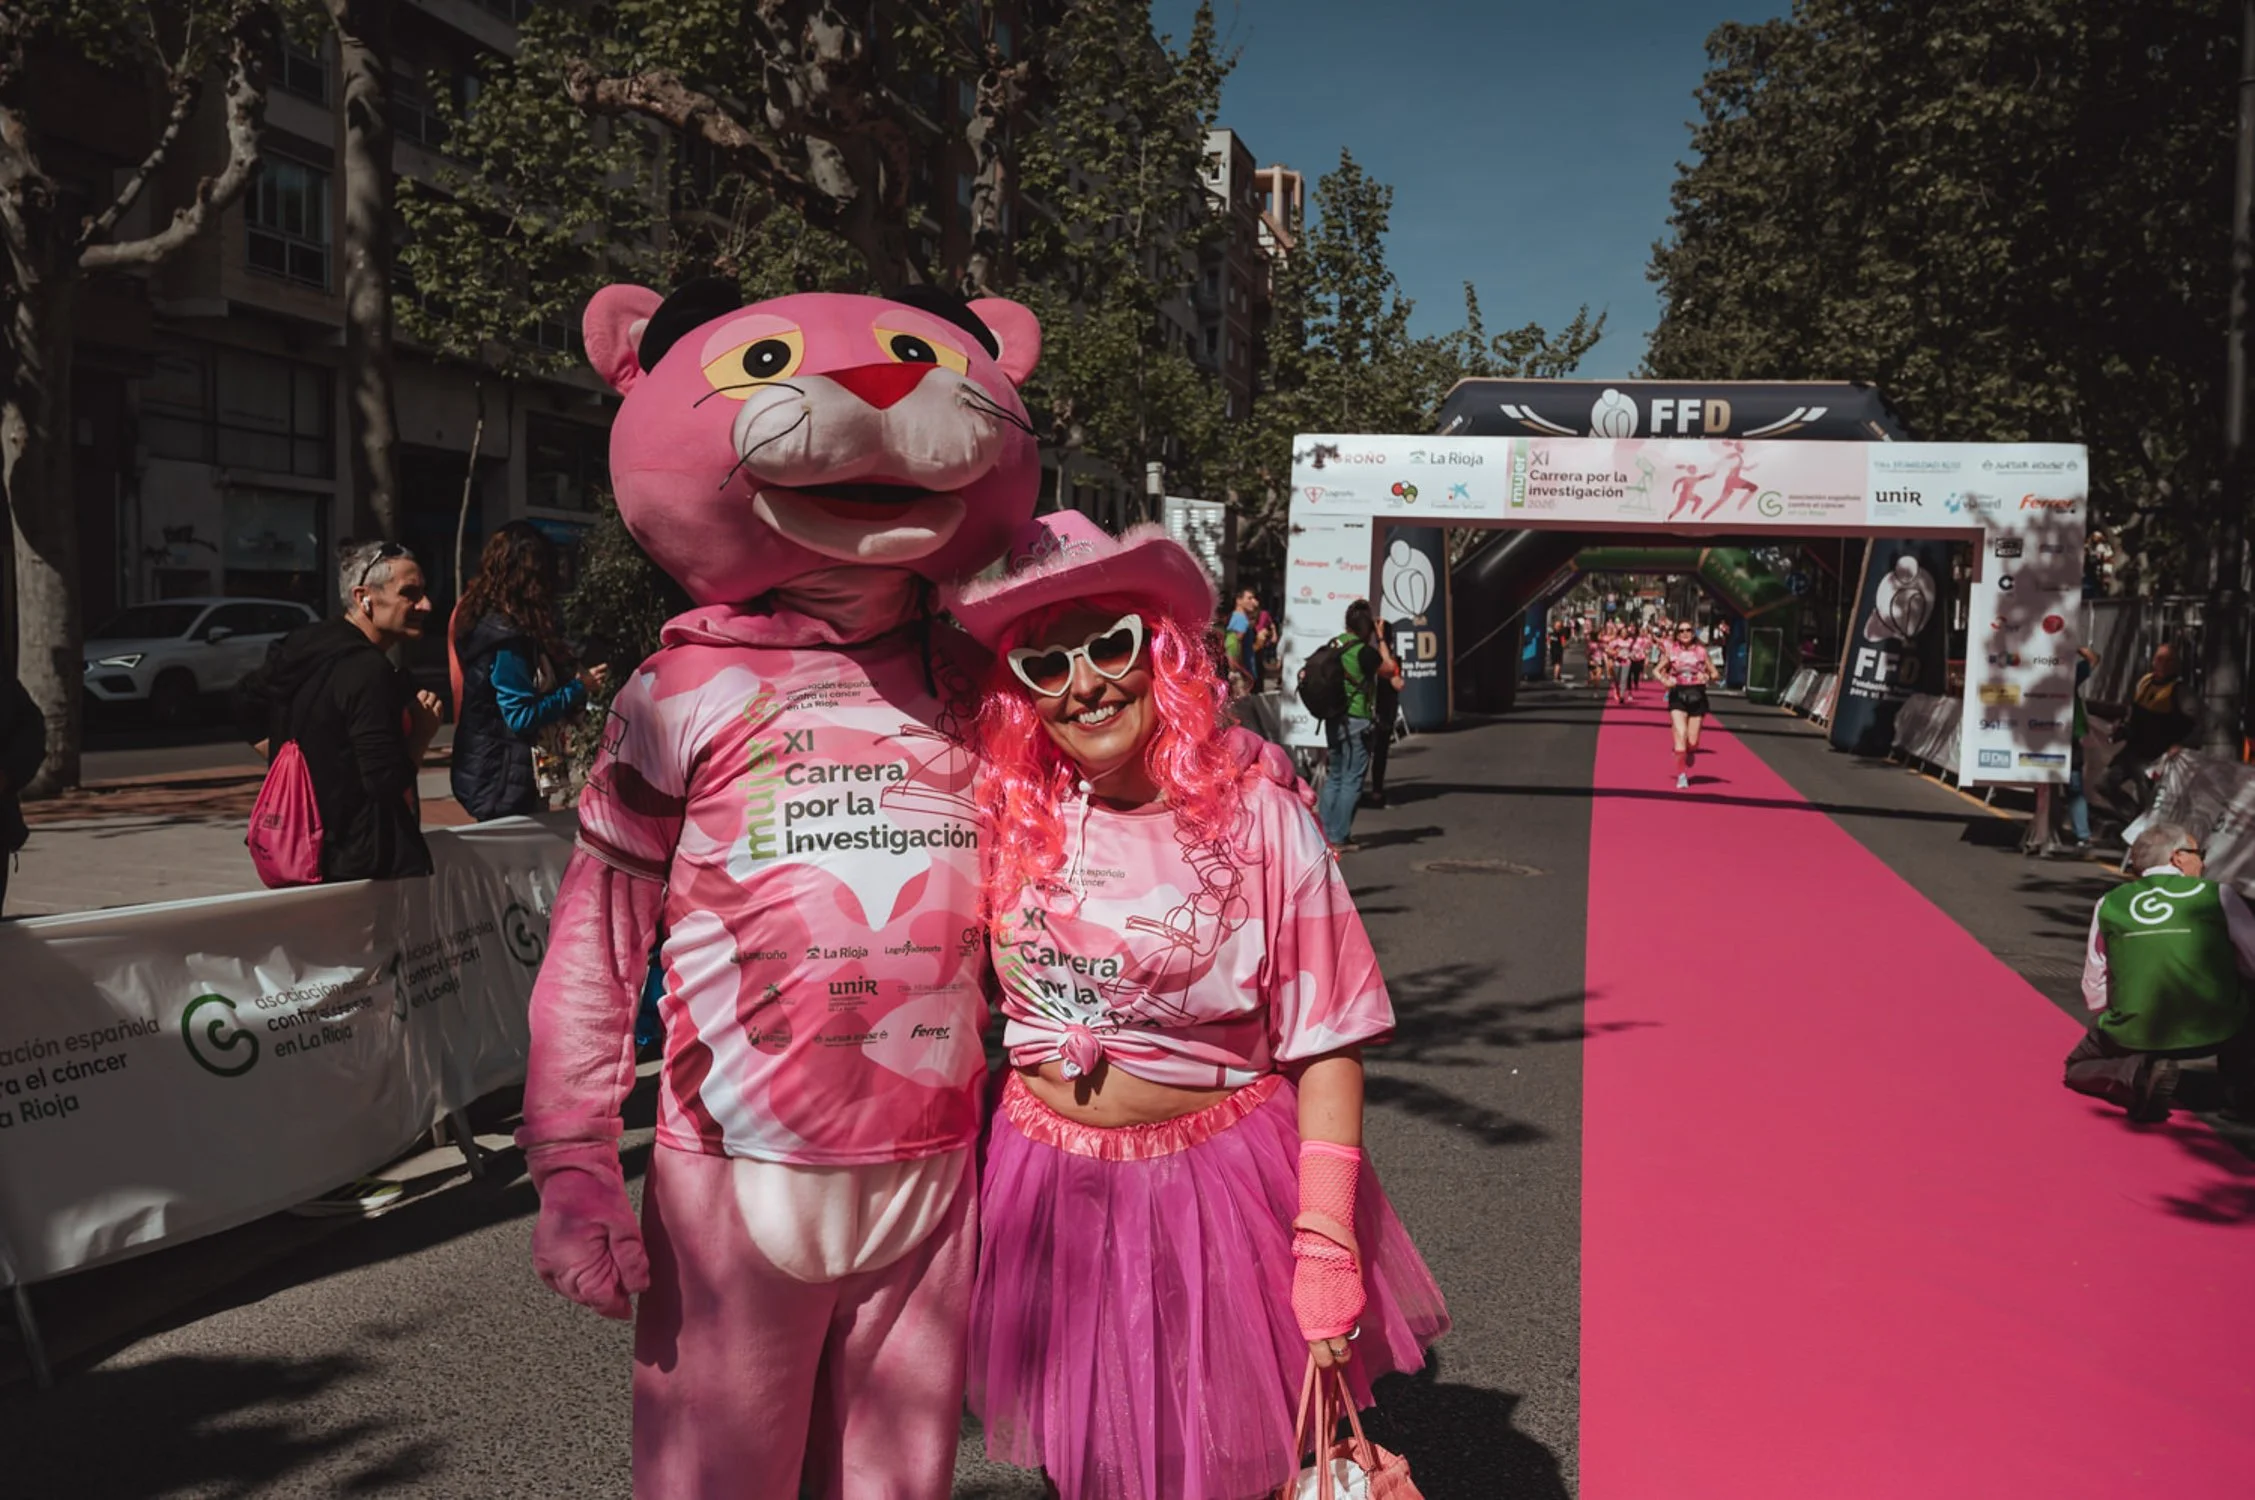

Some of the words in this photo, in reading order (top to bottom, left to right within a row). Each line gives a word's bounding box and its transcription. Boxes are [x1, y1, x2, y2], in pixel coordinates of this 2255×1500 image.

[1650, 399, 1732, 433] FFD
[1430, 452, 1445, 465] La
[1449, 451, 1484, 468] Rioja
[1531, 450, 1549, 466] XI
[1529, 470, 1582, 481] Carrera
[1587, 472, 1611, 485] por
[1614, 472, 1628, 483] la
[1528, 484, 1624, 500] investigación
[1396, 631, 1437, 660] FD
[783, 729, 815, 755] XI
[784, 760, 905, 786] Carrera
[737, 737, 785, 861] mujer
[785, 798, 842, 827] por
[846, 791, 876, 816] la
[786, 823, 979, 856] Investigación
[824, 948, 838, 959] La
[839, 946, 869, 960] Rioja
[255, 982, 341, 1010] asociación
[1075, 982, 1099, 1005] la
[0, 1037, 61, 1067] ación
[65, 1016, 161, 1053] española
[275, 1039, 298, 1058] en
[298, 1032, 321, 1052] La
[25, 1067, 48, 1091] el
[52, 1052, 128, 1085] cáncer
[19, 1093, 81, 1124] Rioja
